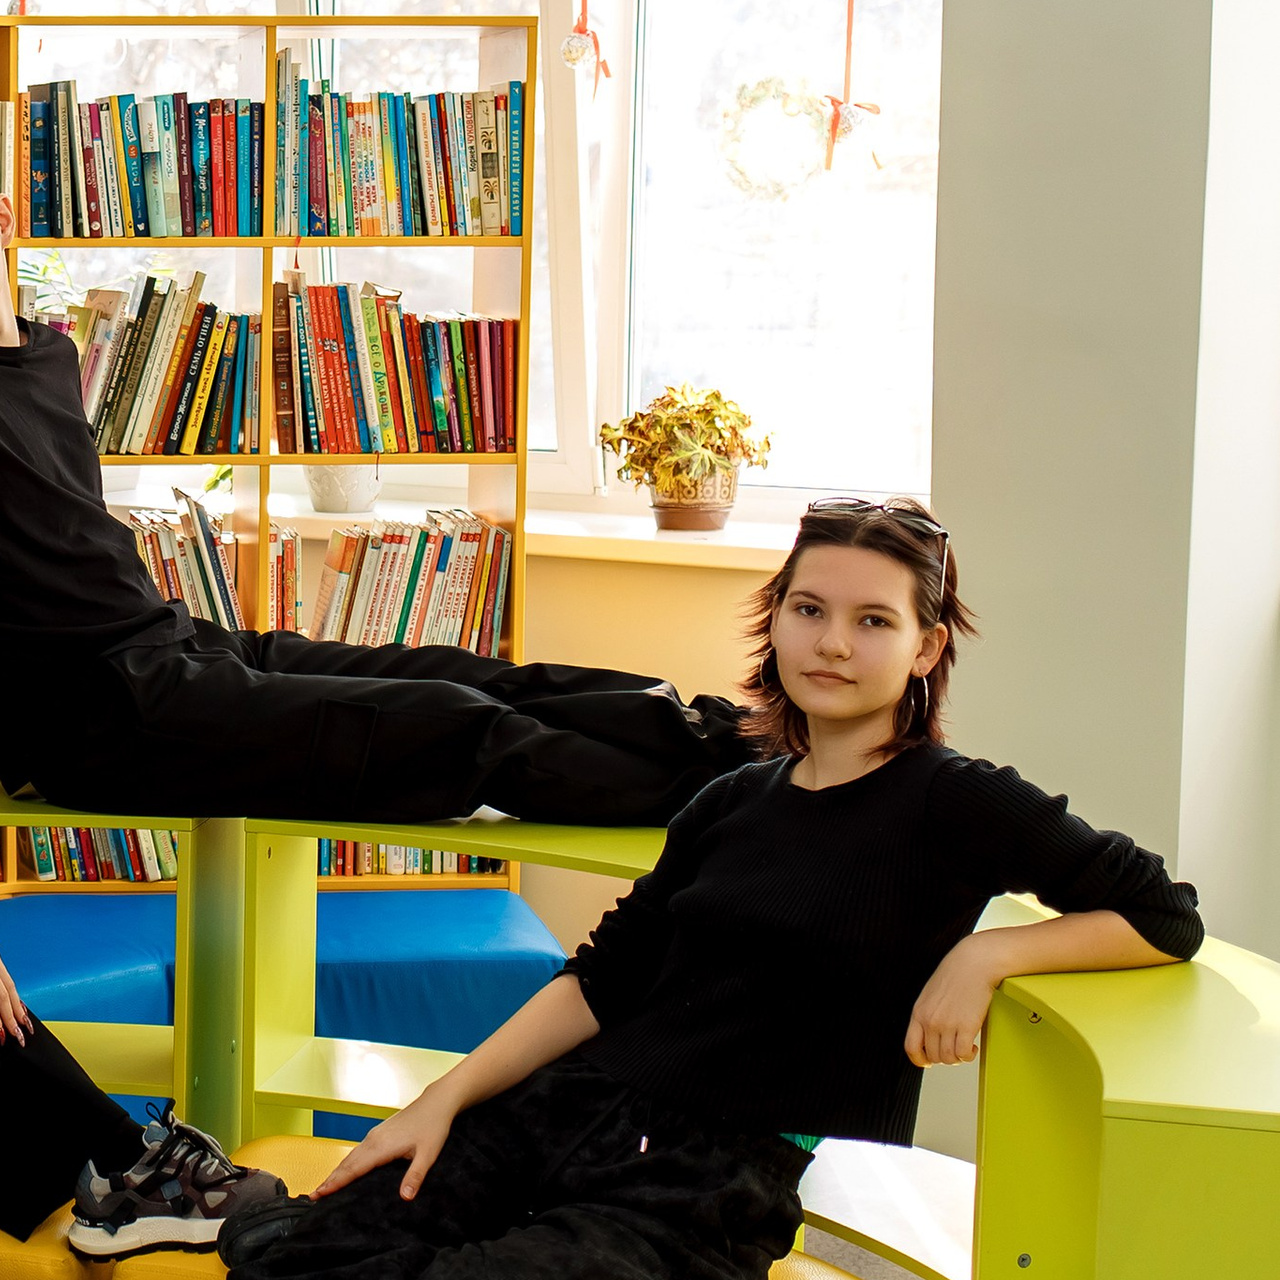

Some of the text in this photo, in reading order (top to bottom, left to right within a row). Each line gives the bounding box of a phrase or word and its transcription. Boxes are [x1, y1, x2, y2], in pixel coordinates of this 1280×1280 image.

[464, 100, 477, 172] Корней ЧУКОВСКИЙ
[125, 340, 148, 395] СОЛНЕЧНЫЙ
[203, 342, 218, 374] квартире
[170, 316, 212, 441] Борис Житков СЕМЬ ОГНЕЙ
[199, 376, 210, 394] моей
[191, 401, 204, 429] Зоопарк
[219, 548, 231, 580] РАССКАЗЫ
